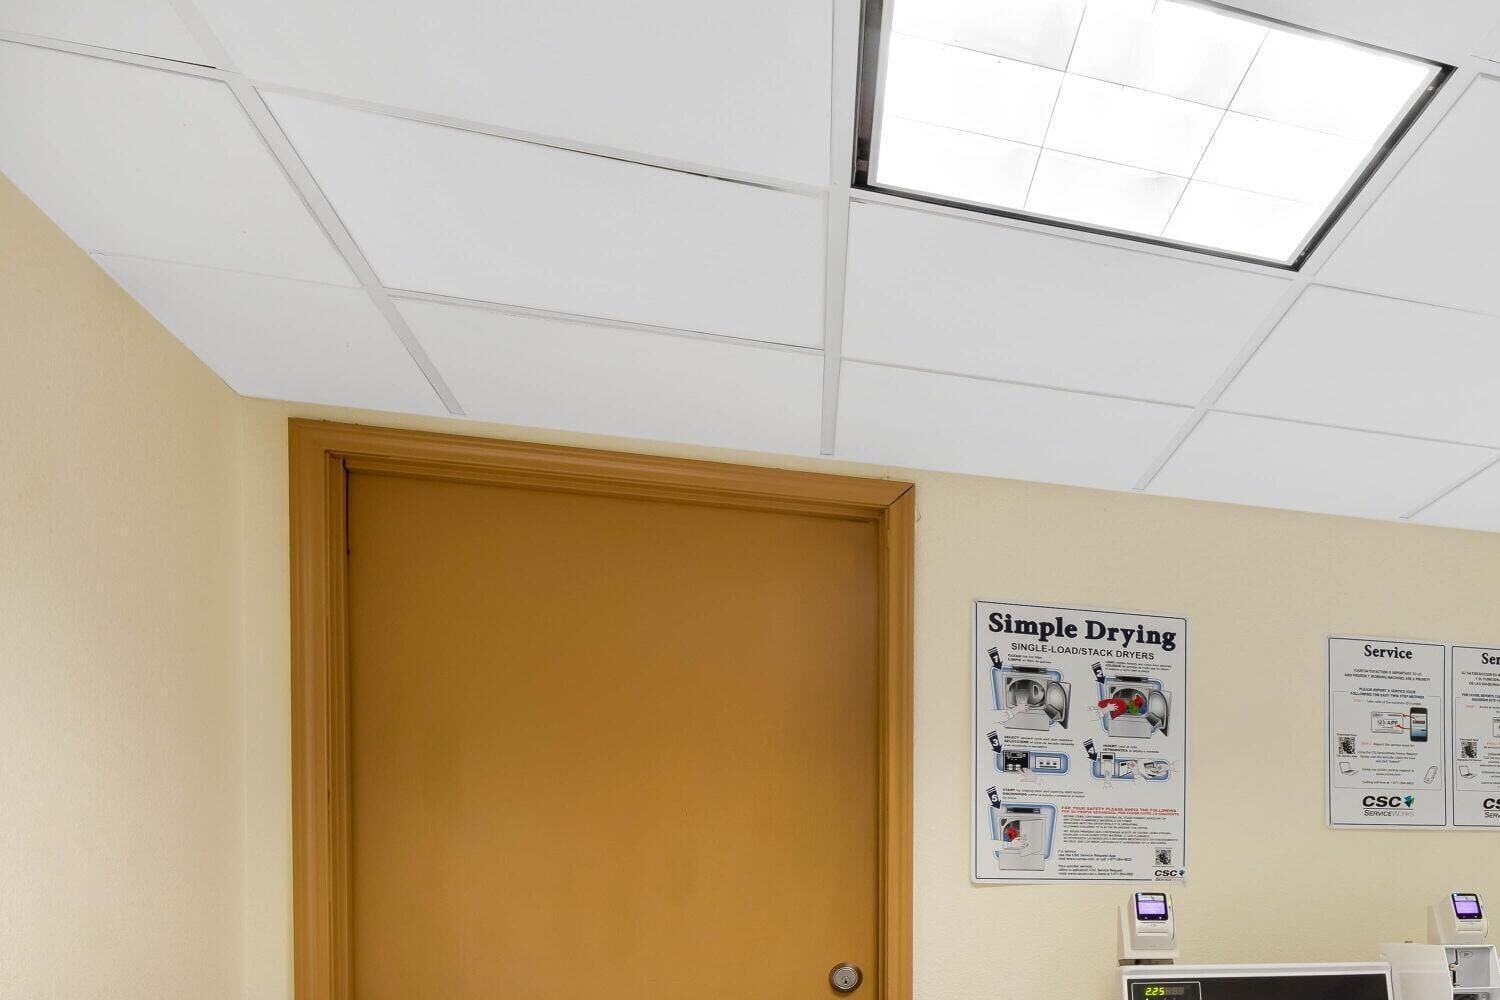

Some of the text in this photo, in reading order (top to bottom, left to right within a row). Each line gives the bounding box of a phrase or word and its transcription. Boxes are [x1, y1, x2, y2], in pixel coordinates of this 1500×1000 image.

[988, 612, 1176, 651] Simple Drying
[1011, 643, 1155, 660] SINGLE-LOAD/STACK DRYERS
[1364, 645, 1412, 659] Service
[1362, 796, 1401, 807] CSC
